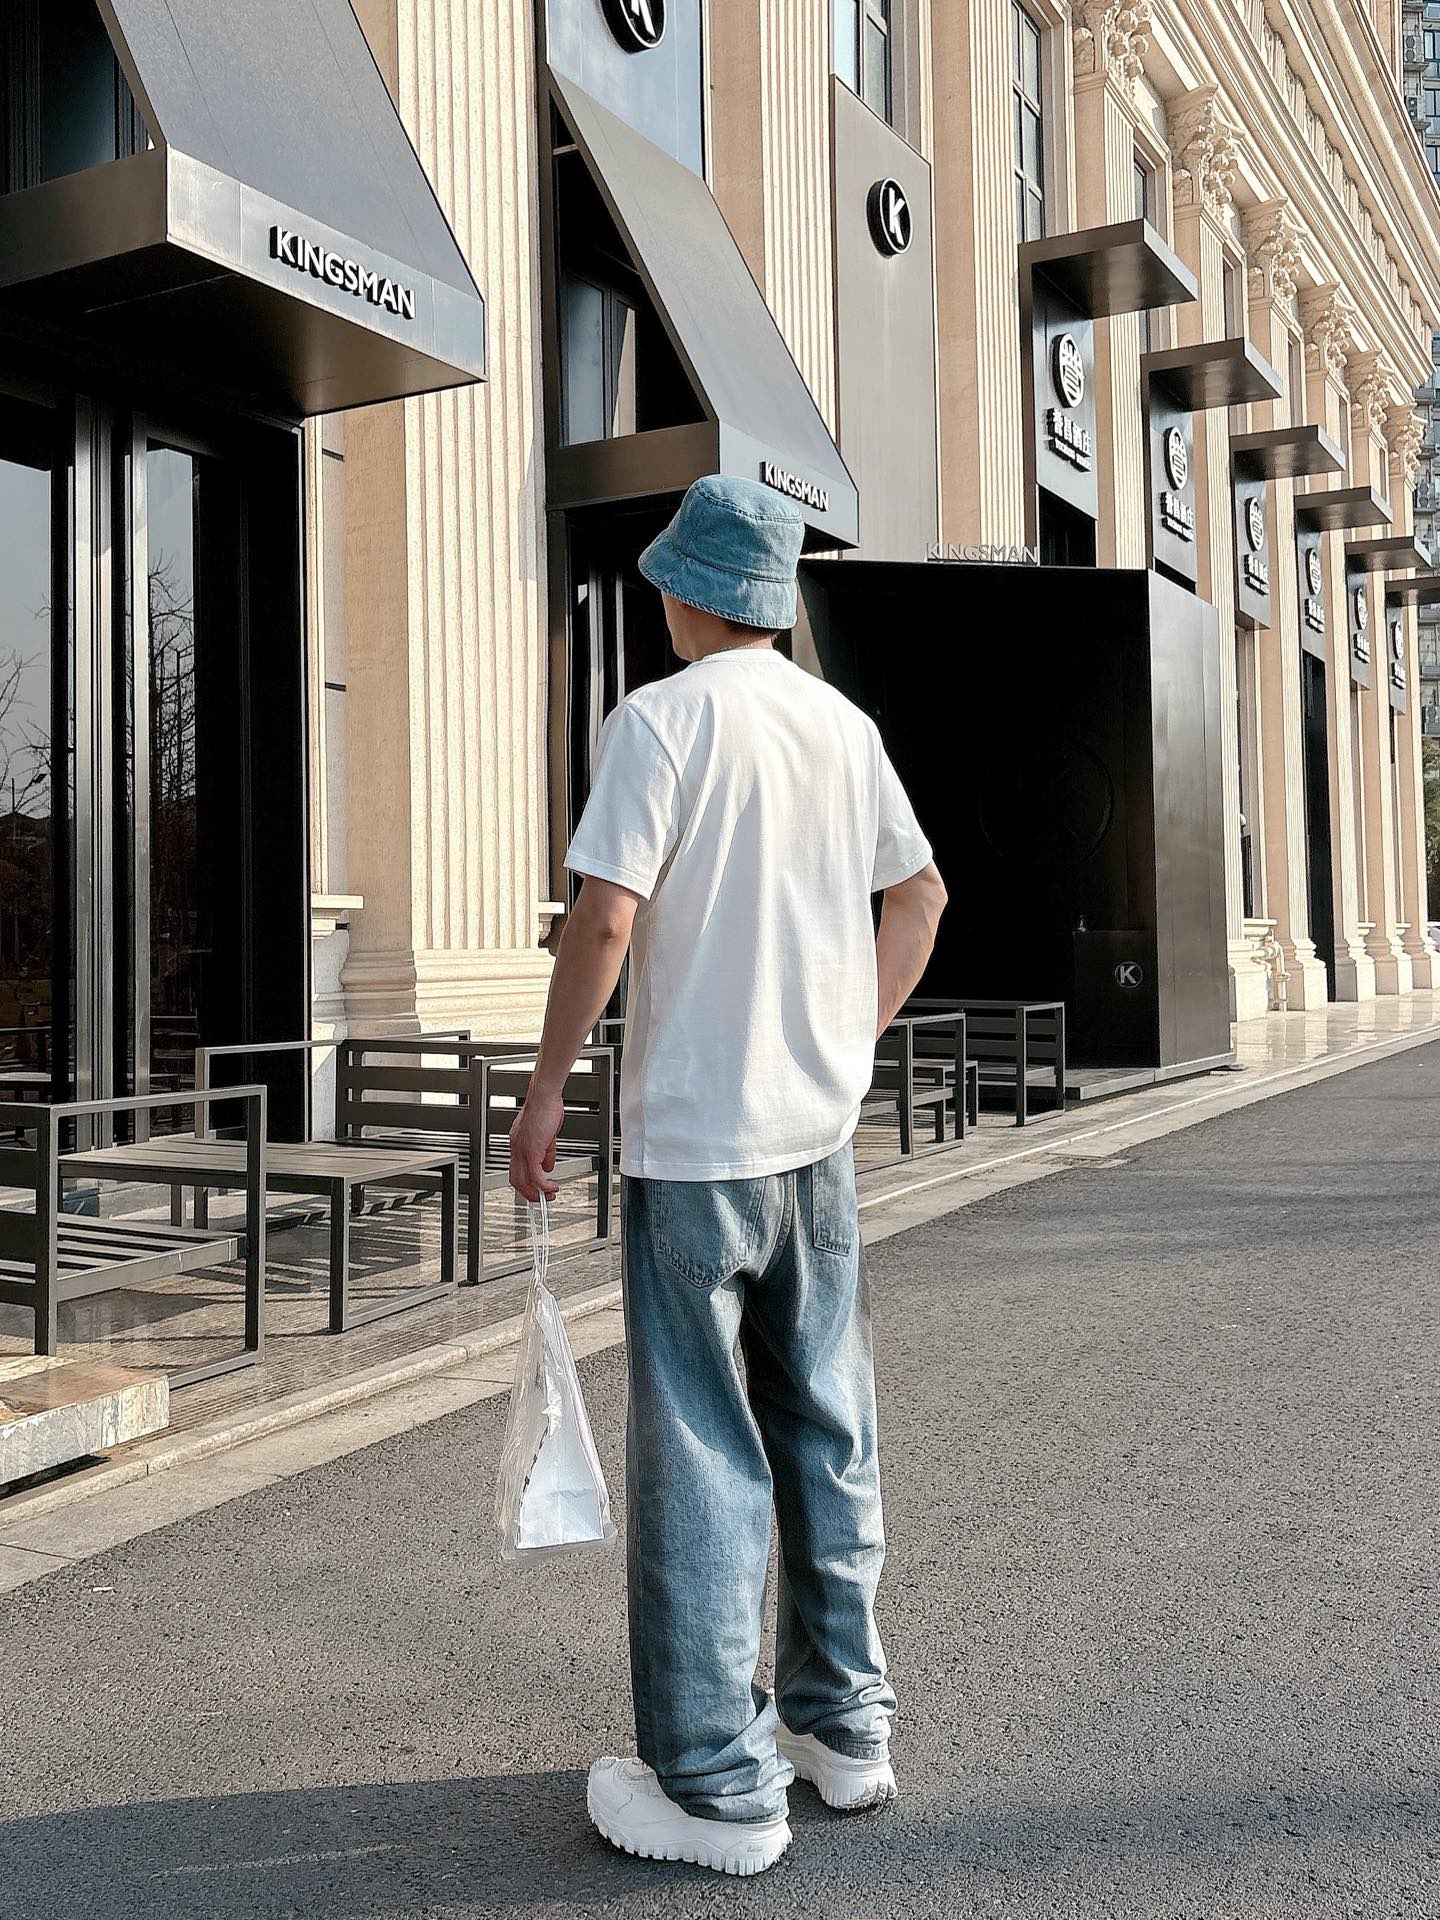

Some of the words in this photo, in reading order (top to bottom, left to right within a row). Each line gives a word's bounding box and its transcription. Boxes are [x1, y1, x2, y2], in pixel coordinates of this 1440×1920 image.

[888, 187, 905, 246] K
[270, 225, 416, 319] KINGSMAN
[763, 461, 829, 511] KINGSMAN
[926, 543, 1037, 563] KINGSMAN
[1120, 965, 1136, 984] K
